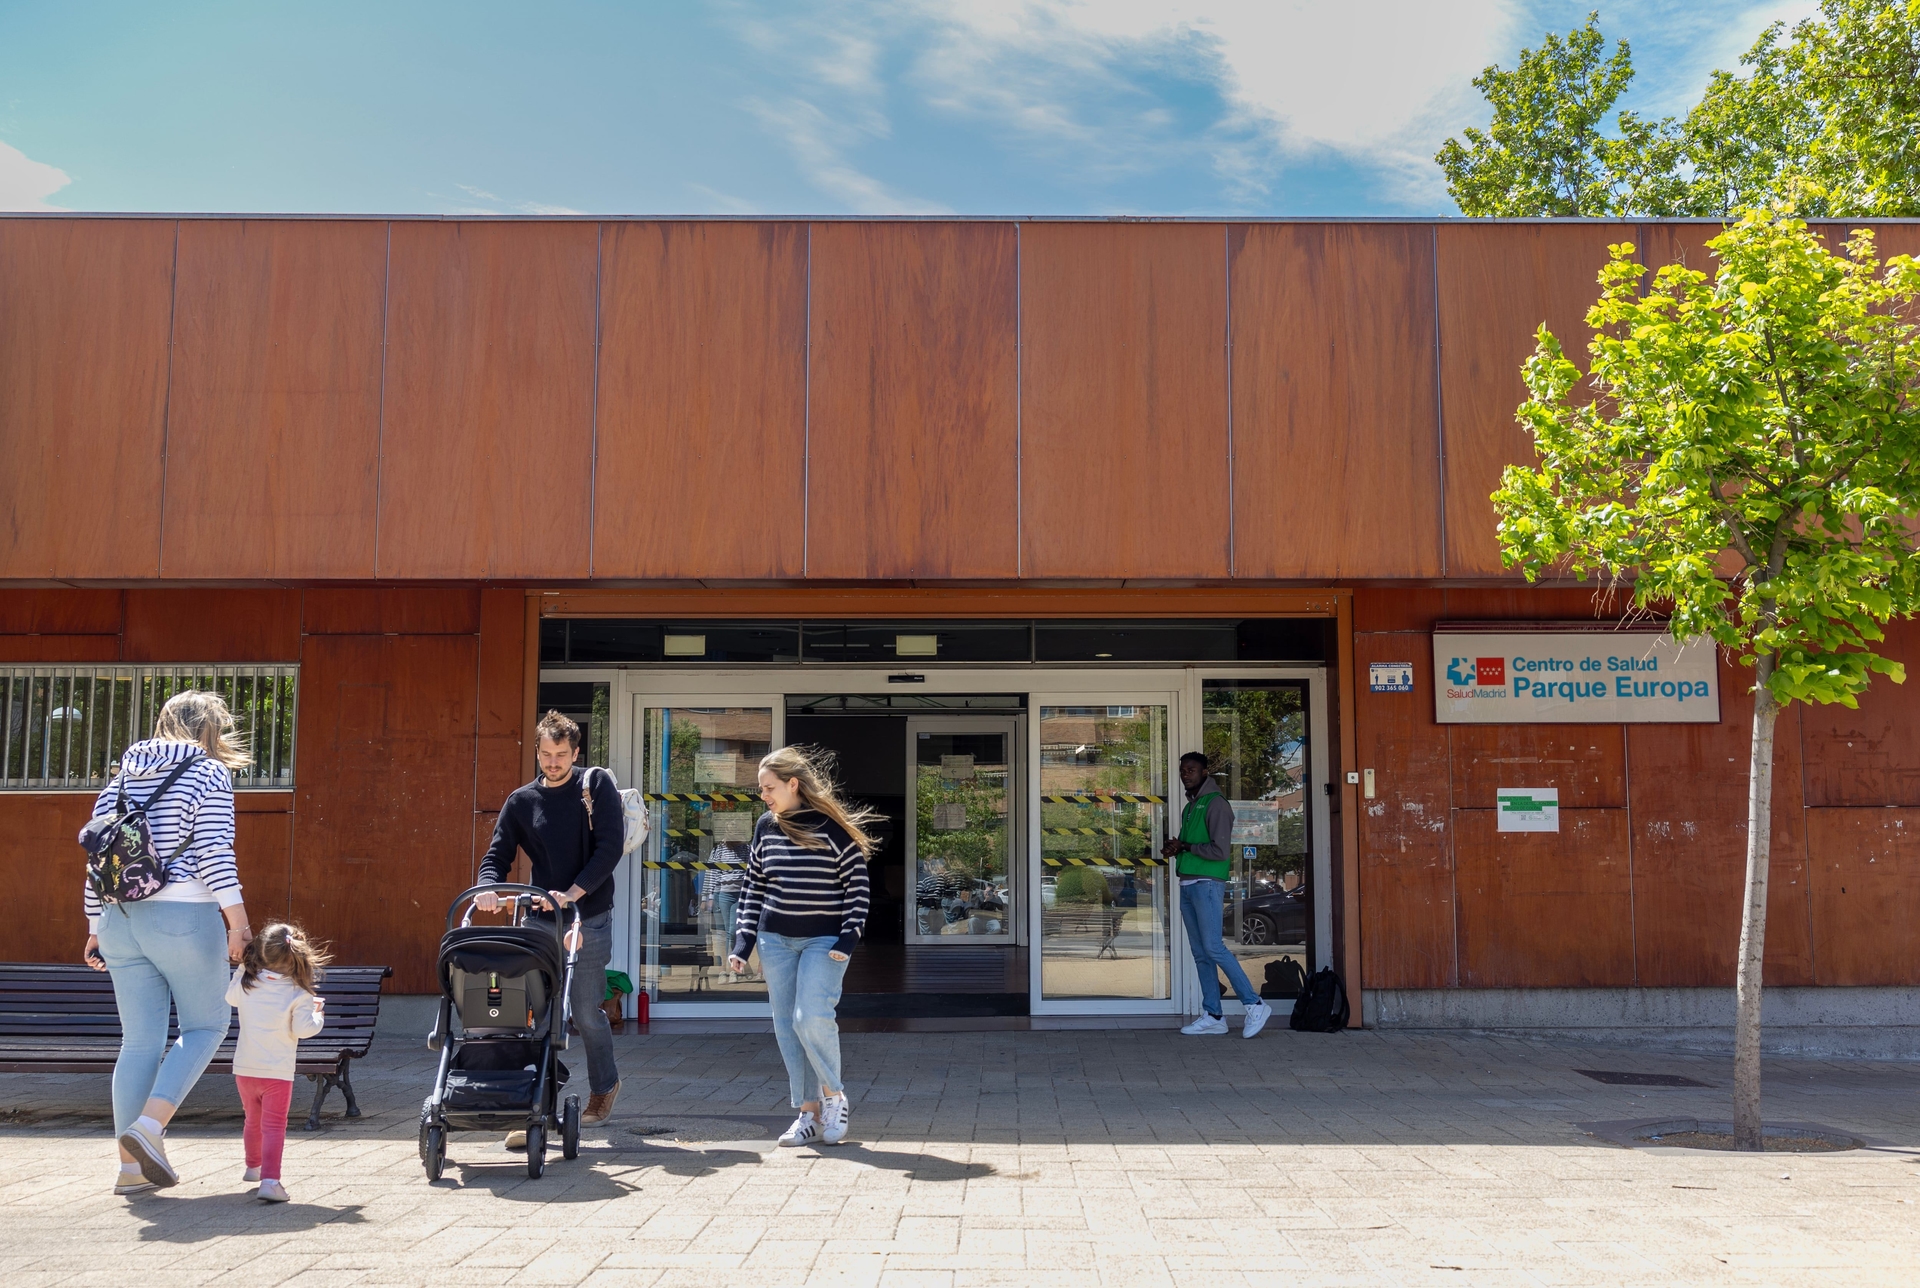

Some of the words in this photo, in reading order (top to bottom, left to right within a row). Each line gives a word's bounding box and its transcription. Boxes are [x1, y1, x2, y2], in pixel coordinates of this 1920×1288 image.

[1512, 657, 1574, 671] Centro
[1579, 657, 1602, 671] de
[1607, 656, 1658, 671] Salud
[1447, 689, 1506, 699] SaludMadrid
[1513, 677, 1607, 702] Parque
[1616, 676, 1709, 702] Europa
